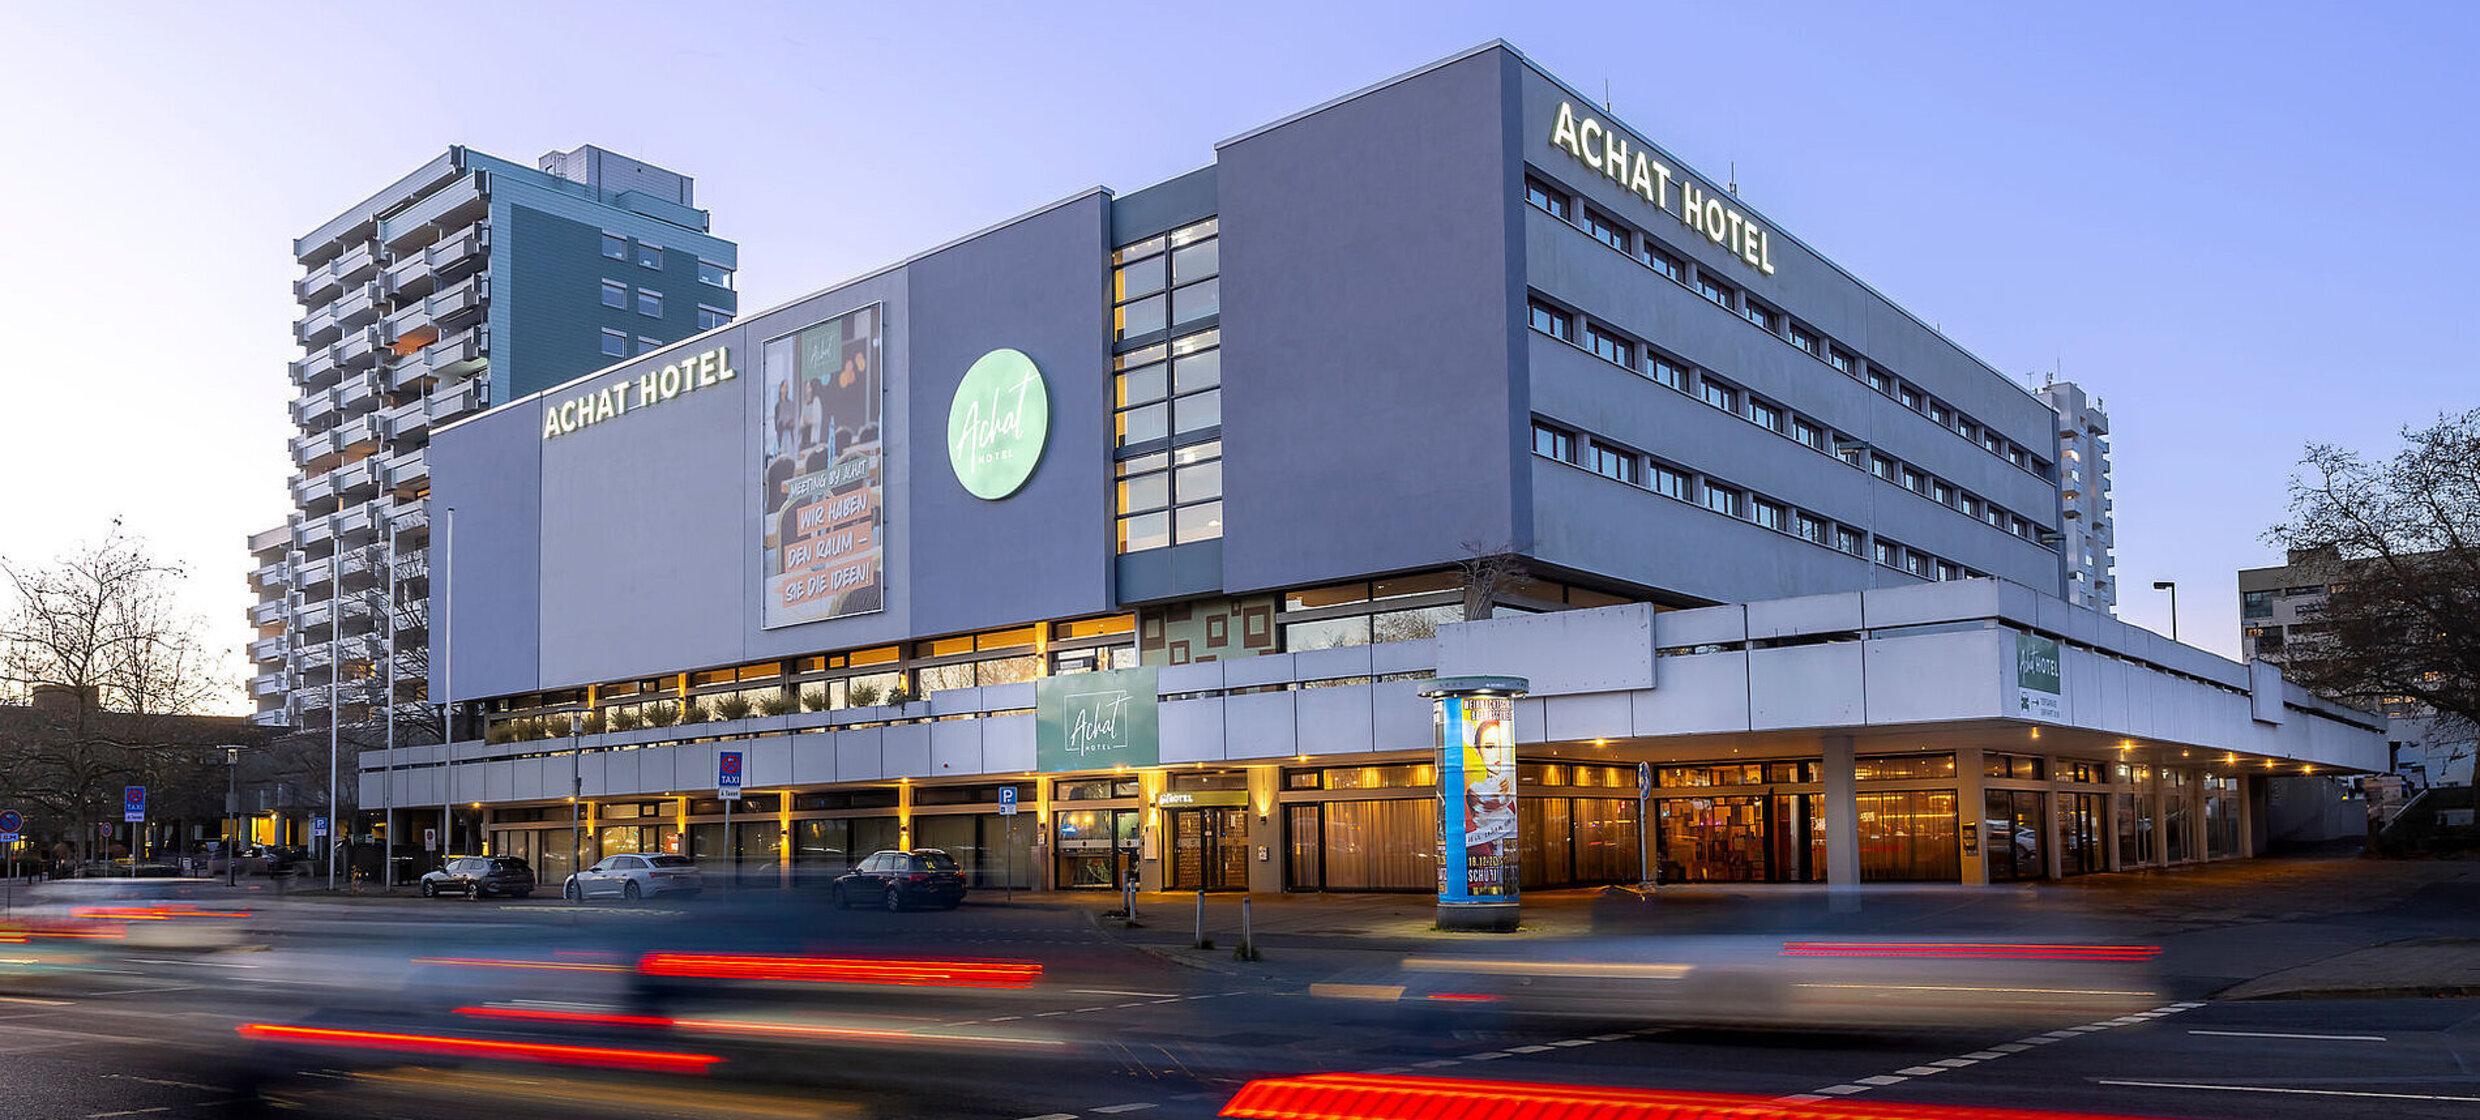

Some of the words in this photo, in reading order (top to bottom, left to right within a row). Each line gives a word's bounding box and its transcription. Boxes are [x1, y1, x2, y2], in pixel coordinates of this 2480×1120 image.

[1552, 101, 1671, 209] ACHAT
[1682, 180, 1775, 275] HOTEL
[543, 380, 631, 439] ACHAT
[640, 346, 736, 406] HOTEL
[955, 369, 1041, 476] Achat
[978, 450, 1014, 464] HOTEL
[789, 474, 827, 499] MEETING
[829, 468, 841, 485] BY
[842, 459, 868, 481] ACHAT
[800, 507, 824, 530] WIR
[828, 492, 869, 522] HABEN
[787, 545, 812, 569] DEN
[816, 531, 853, 559] RAUM
[785, 582, 804, 602] SIE
[807, 575, 828, 598] DIE
[831, 562, 871, 592] IDEEN!
[2036, 656, 2059, 677] HOTEL
[1070, 693, 1133, 757] Achat
[721, 776, 740, 784] TAXI
[1003, 789, 1013, 804] P
